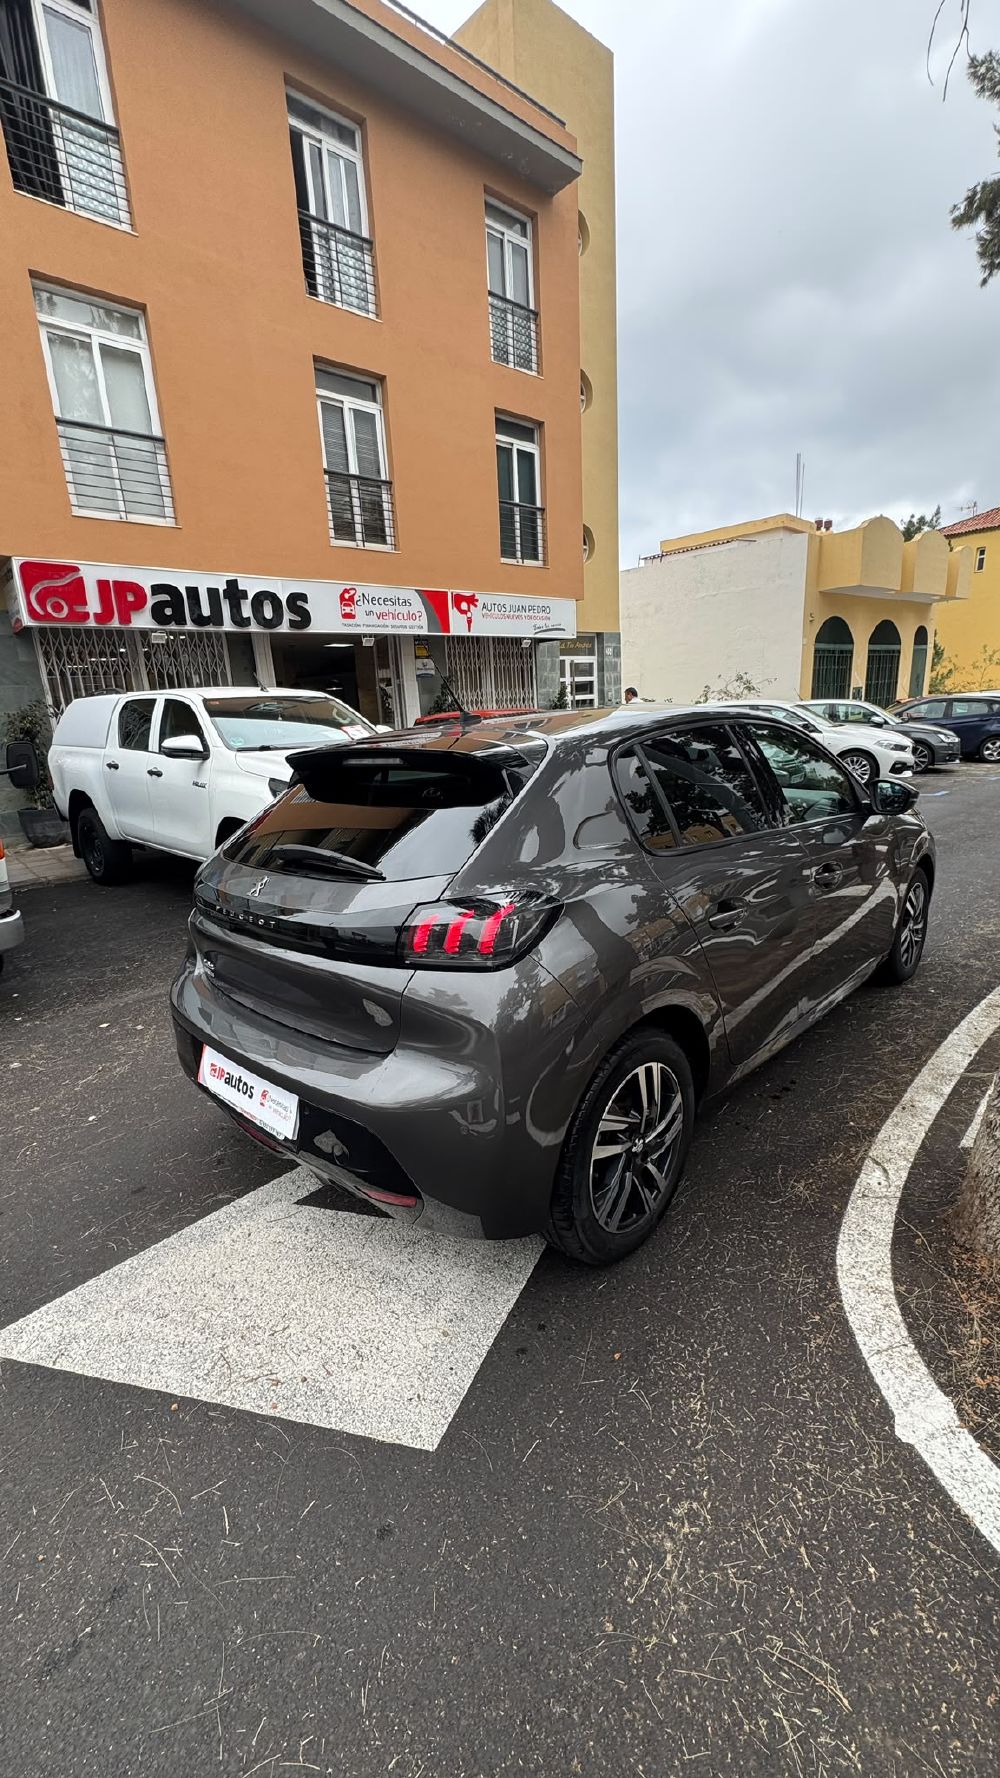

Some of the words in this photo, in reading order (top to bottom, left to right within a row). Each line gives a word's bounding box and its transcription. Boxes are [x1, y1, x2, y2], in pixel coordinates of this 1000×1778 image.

[93, 578, 312, 630] JPautos
[356, 592, 412, 607] ¿Necesitas
[375, 609, 423, 622] vehículo?
[481, 602, 507, 613] AUTOS
[508, 603, 527, 614] JUAN
[528, 604, 551, 615] PEDRO
[216, 905, 276, 928] PEUGEOT
